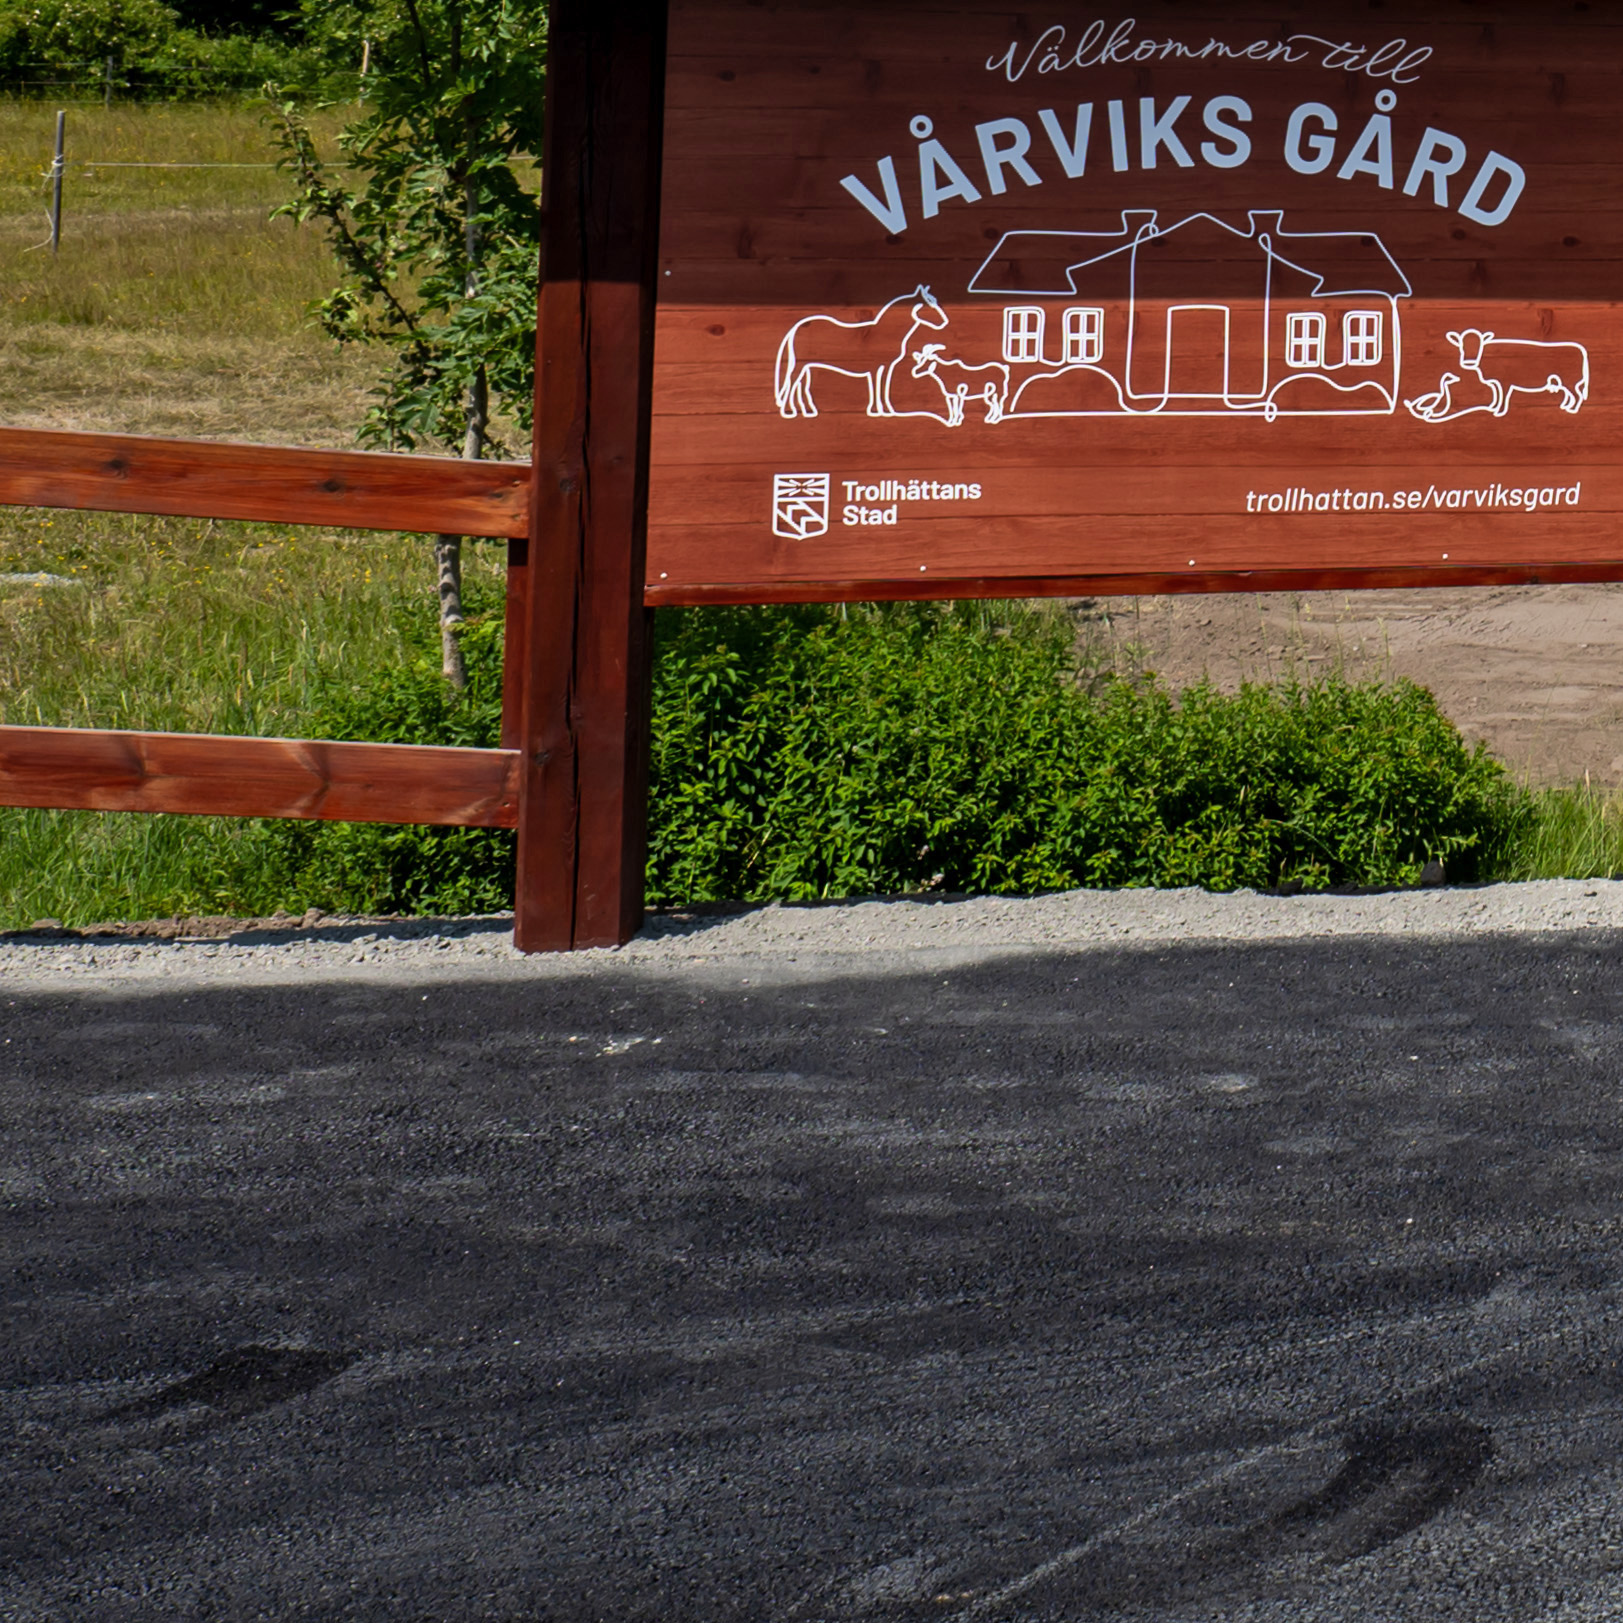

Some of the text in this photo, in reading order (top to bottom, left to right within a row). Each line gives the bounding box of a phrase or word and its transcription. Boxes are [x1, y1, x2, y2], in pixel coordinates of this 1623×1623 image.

[985, 17, 1434, 84] Välkommen till
[838, 88, 1527, 237] VÅRVIKS GÅRD
[841, 479, 983, 503] Trollhättans
[1245, 480, 1583, 513] trollhattan.se/varviksgard
[841, 503, 899, 527] Stad
